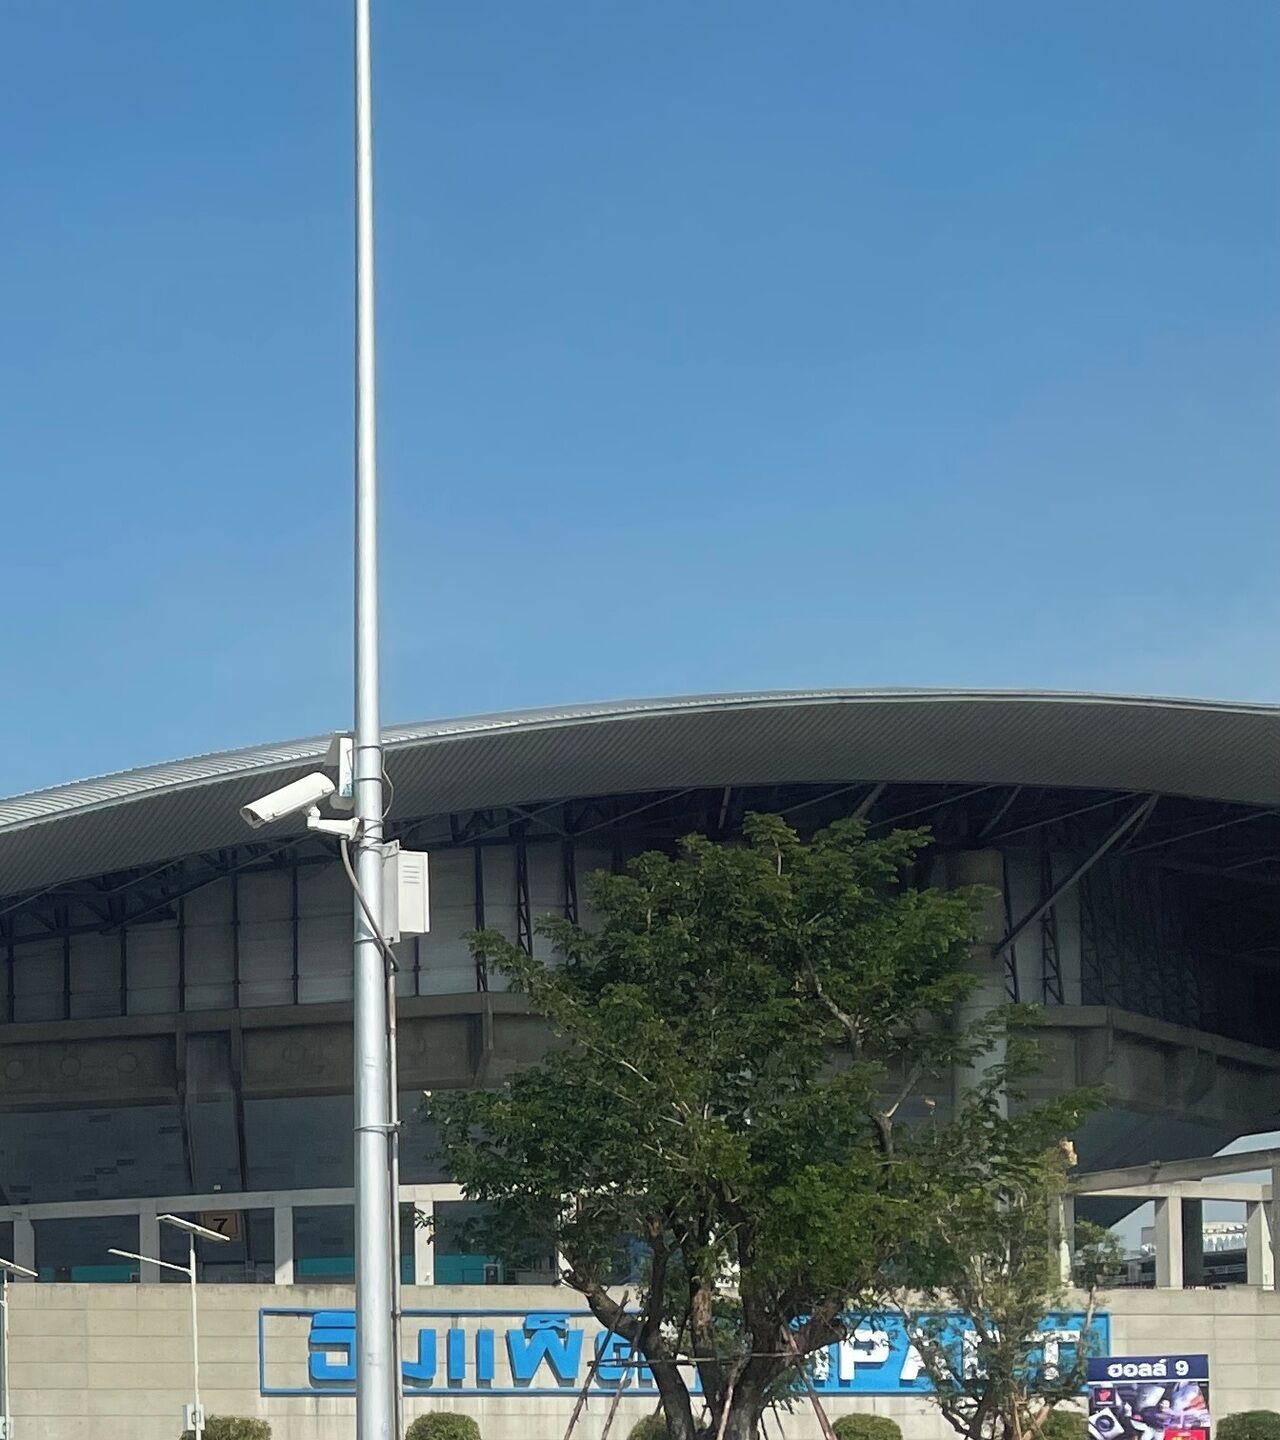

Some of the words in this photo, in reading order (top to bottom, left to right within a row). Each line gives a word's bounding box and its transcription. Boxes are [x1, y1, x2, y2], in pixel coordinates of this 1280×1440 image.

[213, 1218, 228, 1233] 7
[812, 1329, 1081, 1381] PACT
[1107, 1358, 1167, 1378] ฮอลล์
[1175, 1360, 1189, 1376] 9
